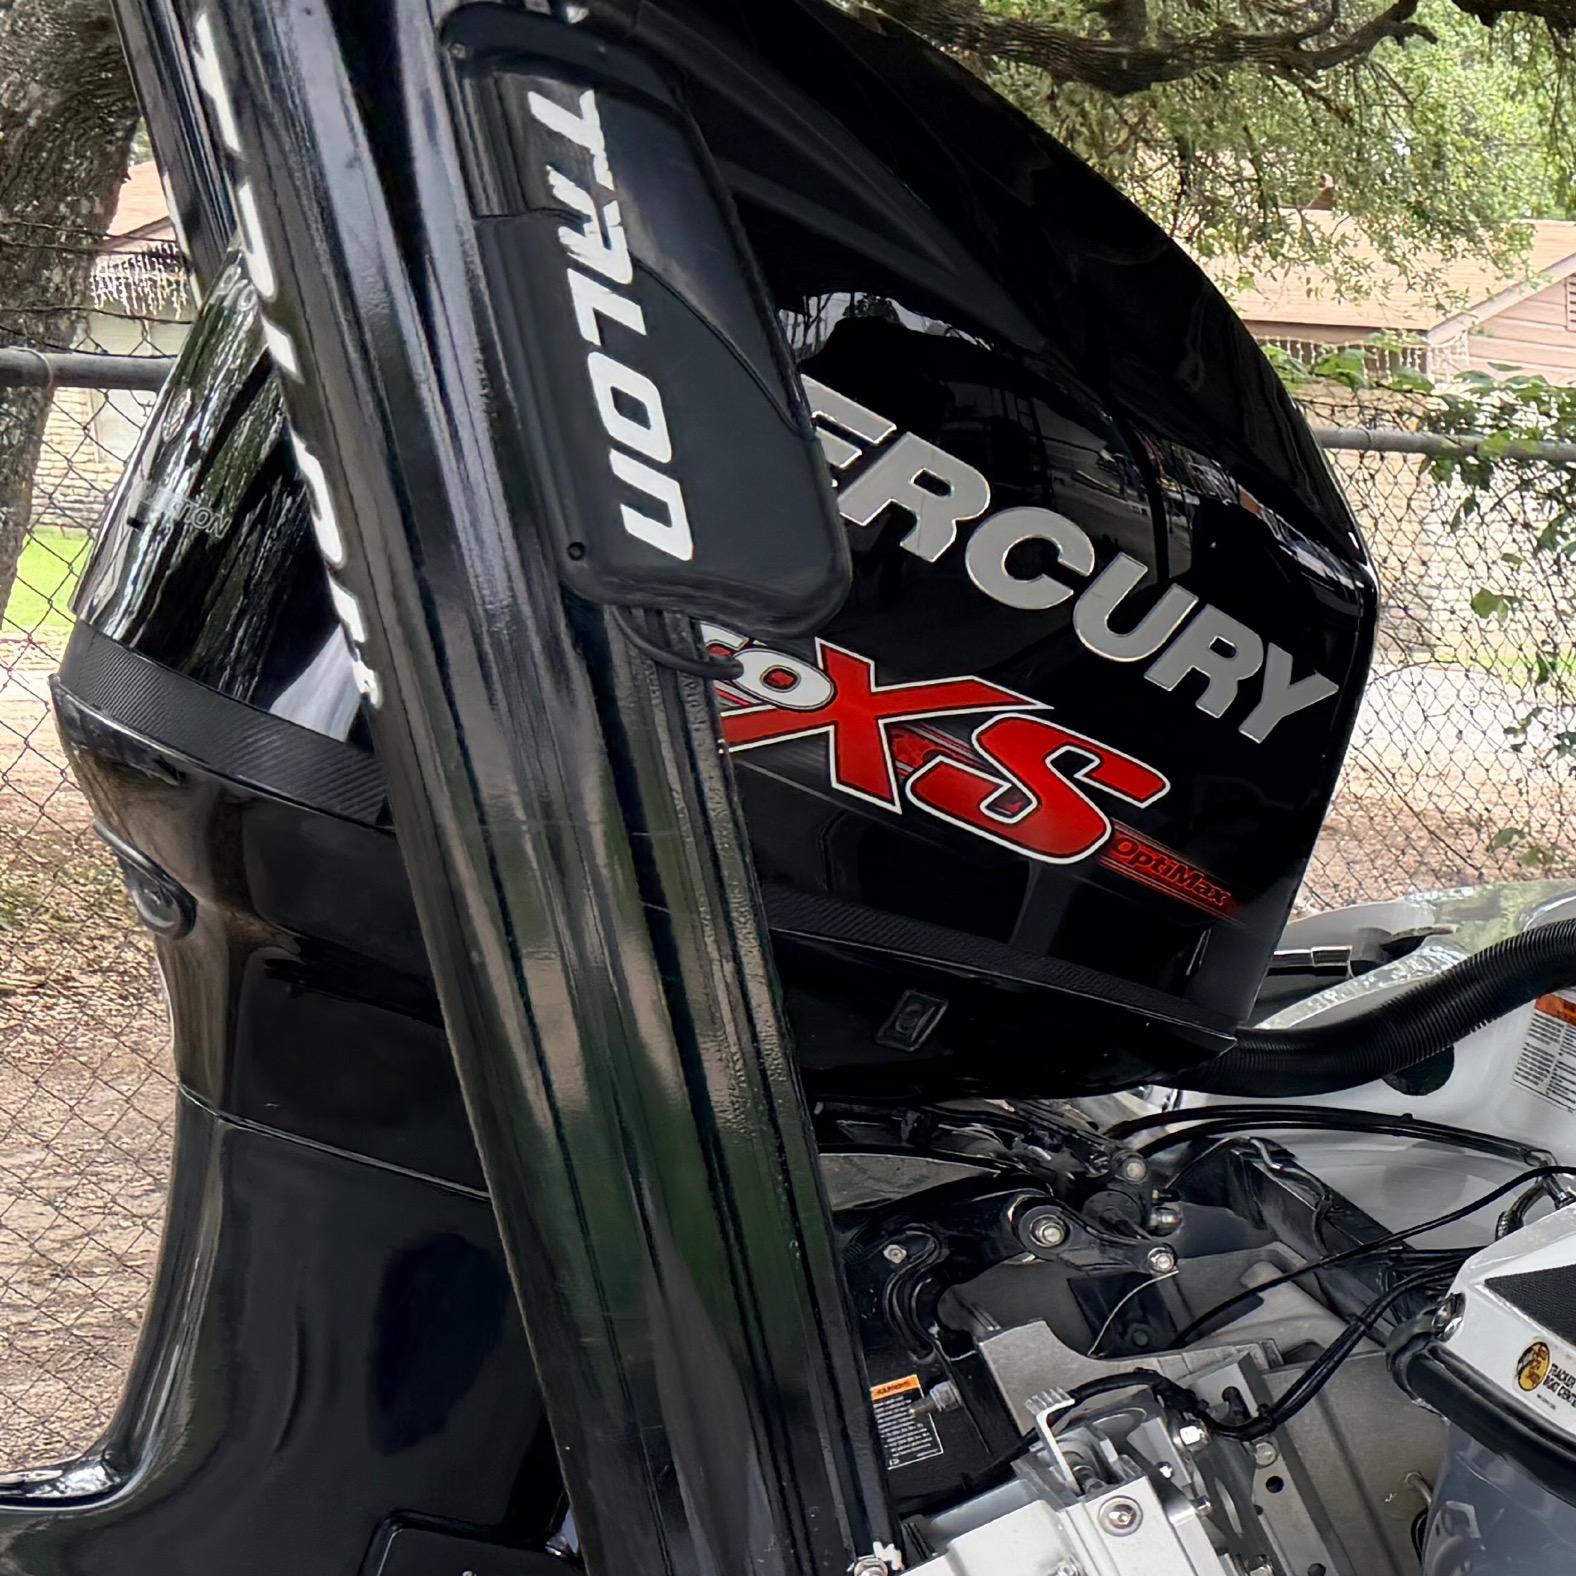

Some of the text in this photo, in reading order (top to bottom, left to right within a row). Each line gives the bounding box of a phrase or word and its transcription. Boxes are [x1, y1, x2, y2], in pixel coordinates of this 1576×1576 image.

[526, 88, 694, 562] TALON
[799, 375, 1339, 746] ERCURY
[1112, 834, 1232, 907] OptiMax
